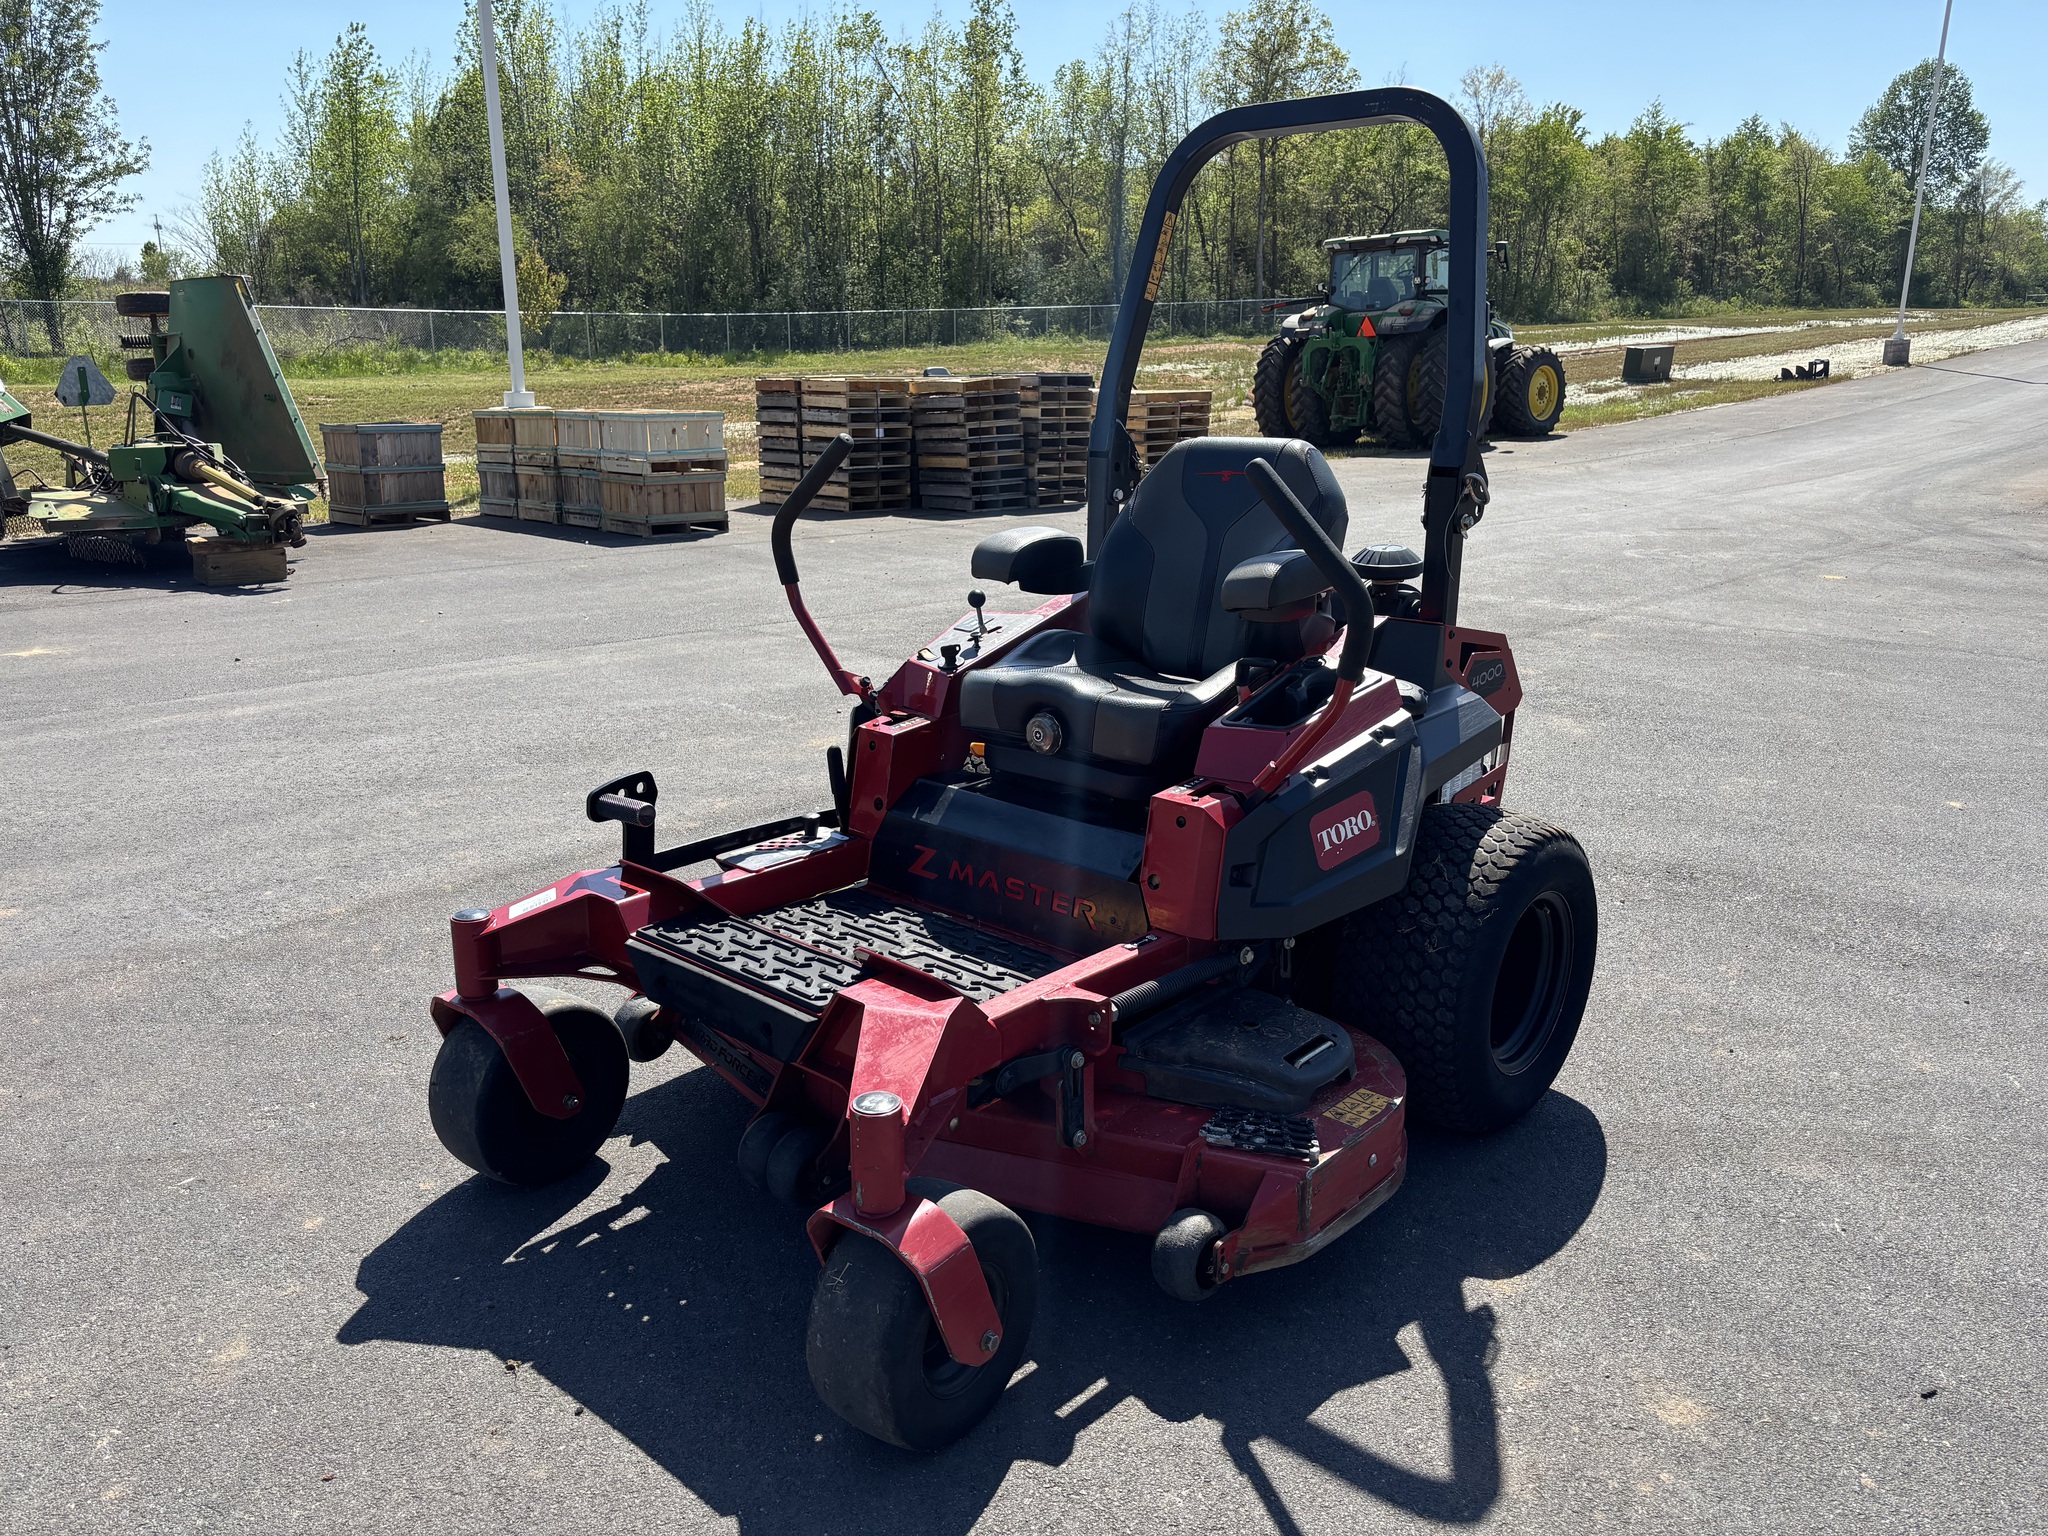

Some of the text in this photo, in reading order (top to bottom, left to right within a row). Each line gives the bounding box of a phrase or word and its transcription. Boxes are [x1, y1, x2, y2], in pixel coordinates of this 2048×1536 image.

[1472, 664, 1503, 687] 4000
[1317, 809, 1372, 852] TORO
[907, 844, 1099, 932] Z MASTER
[718, 1046, 756, 1082] FORCE
